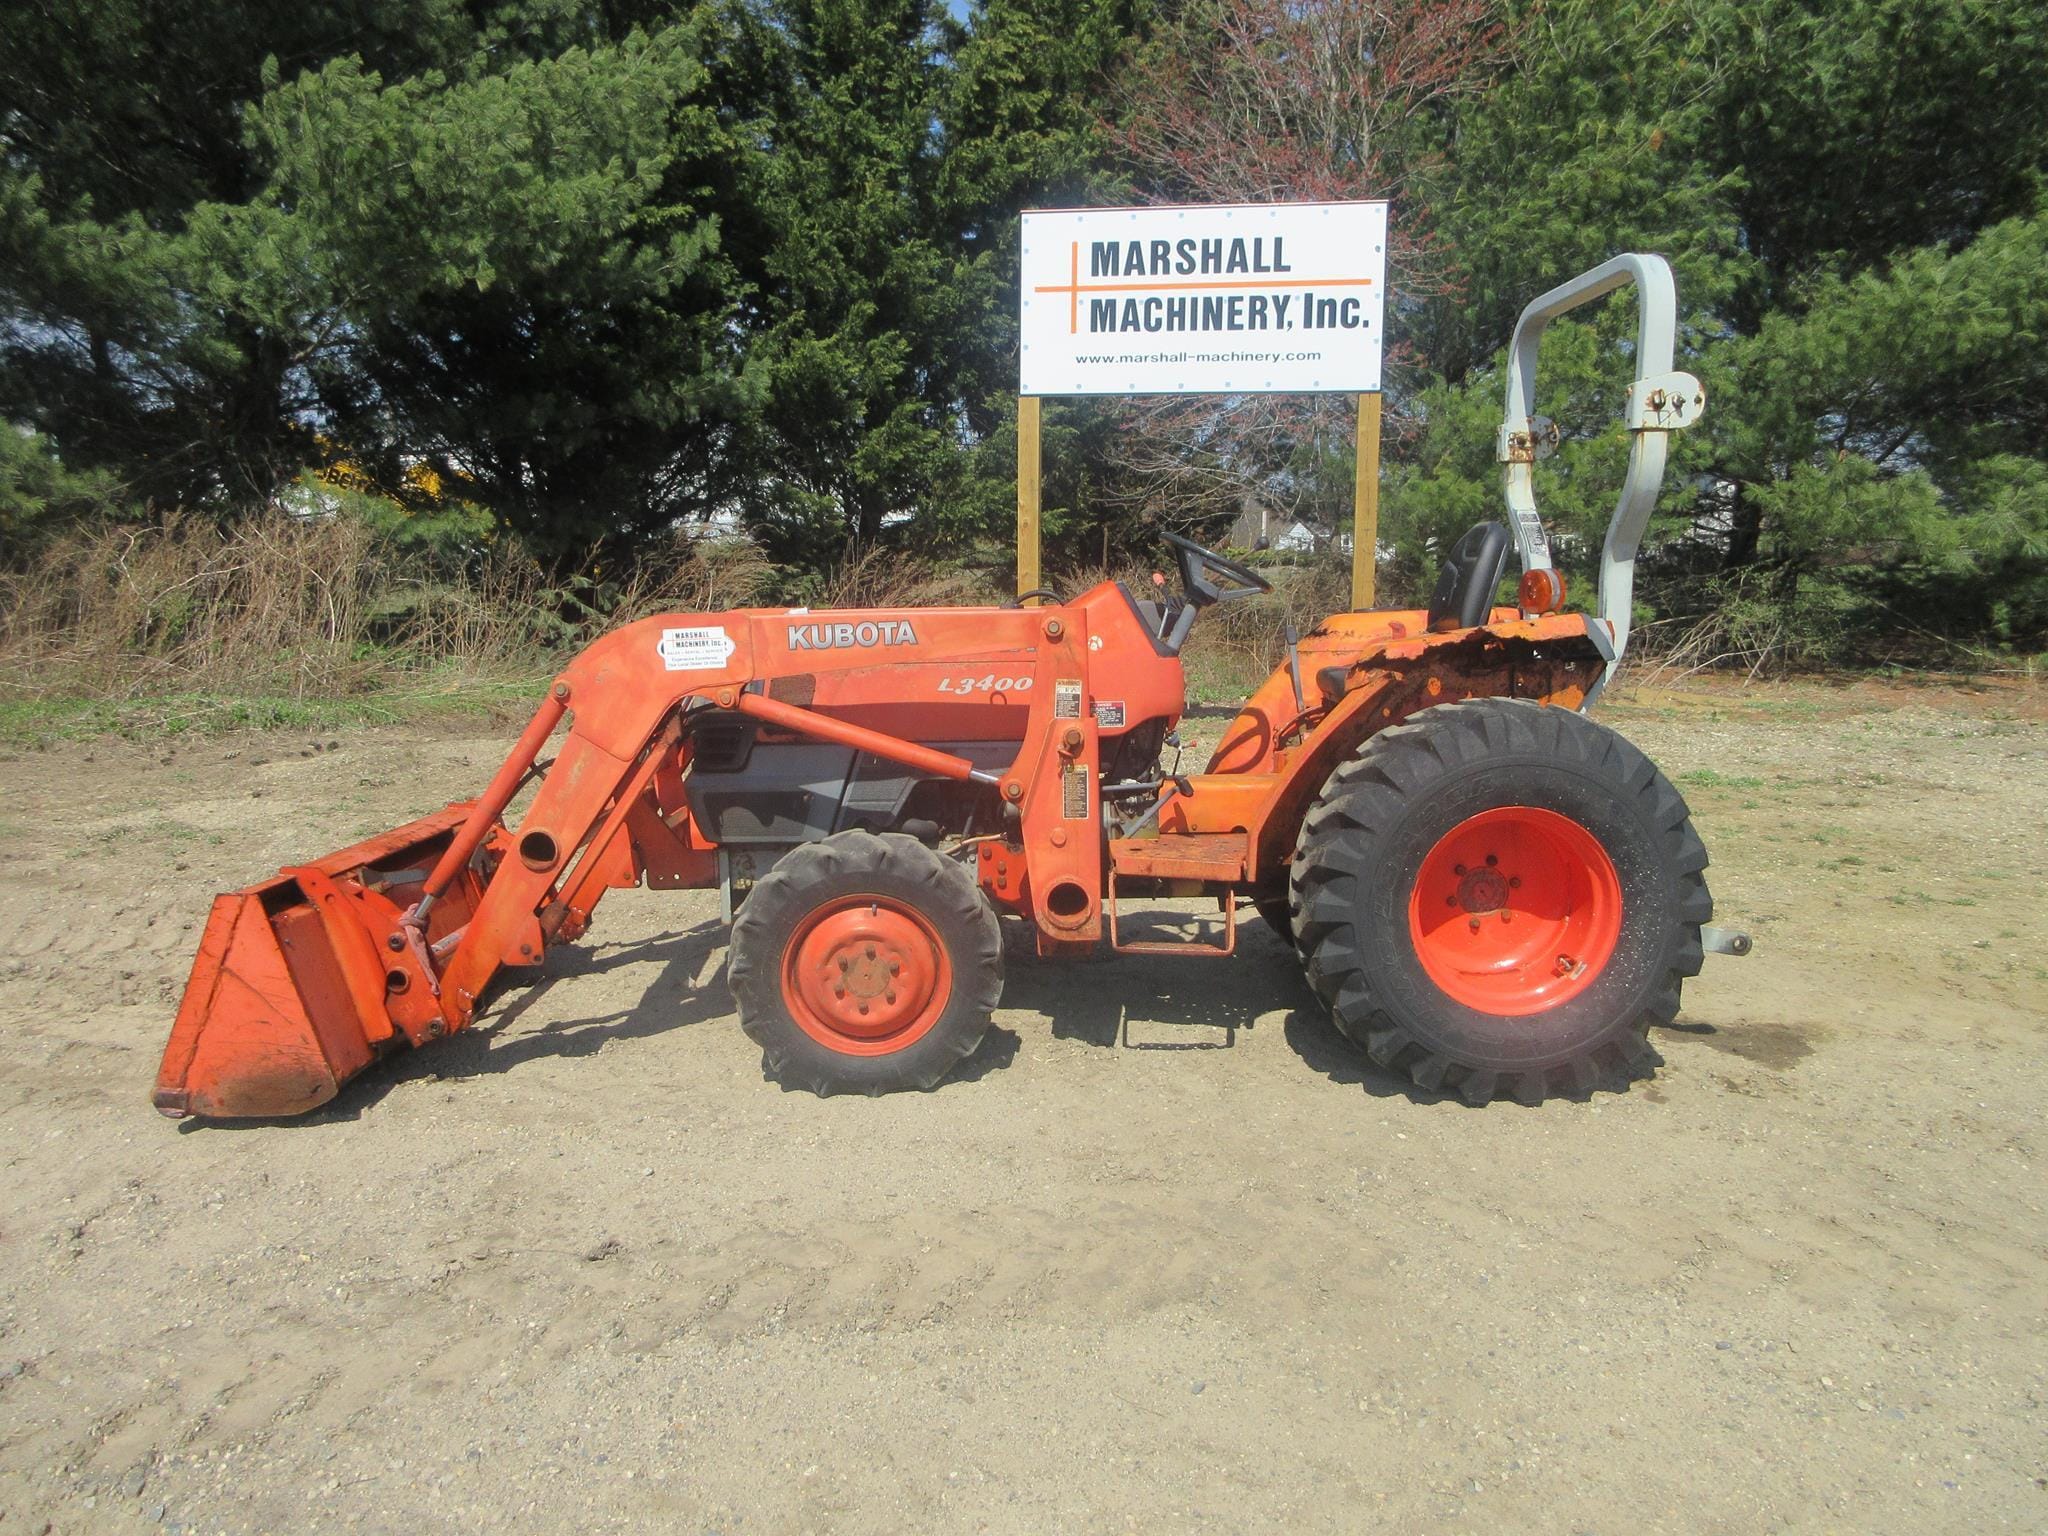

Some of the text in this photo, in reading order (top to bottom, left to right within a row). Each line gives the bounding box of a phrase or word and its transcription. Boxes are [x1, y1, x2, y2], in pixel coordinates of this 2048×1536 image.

[1090, 237, 1291, 277] MARSHALL
[1089, 293, 1370, 333] MACHINERY, Inc.
[1076, 350, 1321, 364] www.marshall-machinery.com
[788, 620, 918, 650] KUBOTA
[937, 674, 1034, 695] L3400
